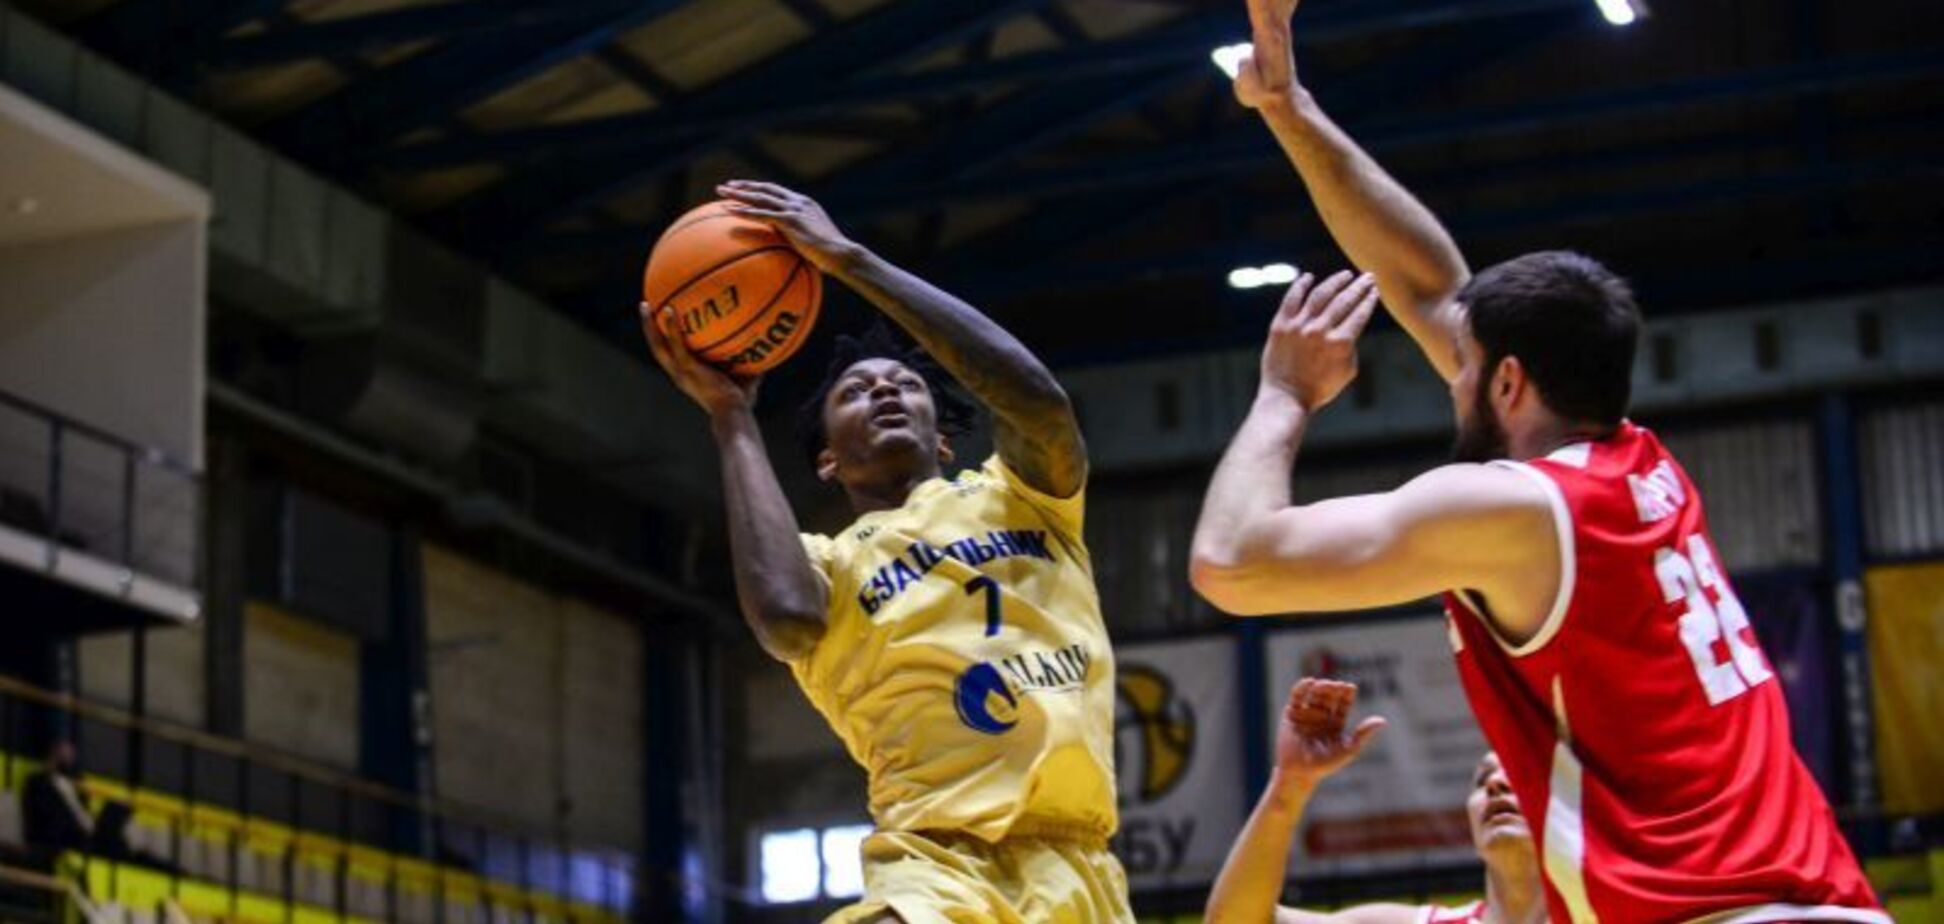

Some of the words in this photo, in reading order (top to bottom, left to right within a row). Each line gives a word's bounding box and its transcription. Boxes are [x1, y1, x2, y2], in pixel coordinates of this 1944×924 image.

[965, 576, 1000, 637] 7
[1655, 533, 1773, 706] 22
[1113, 816, 1194, 874] БУ
